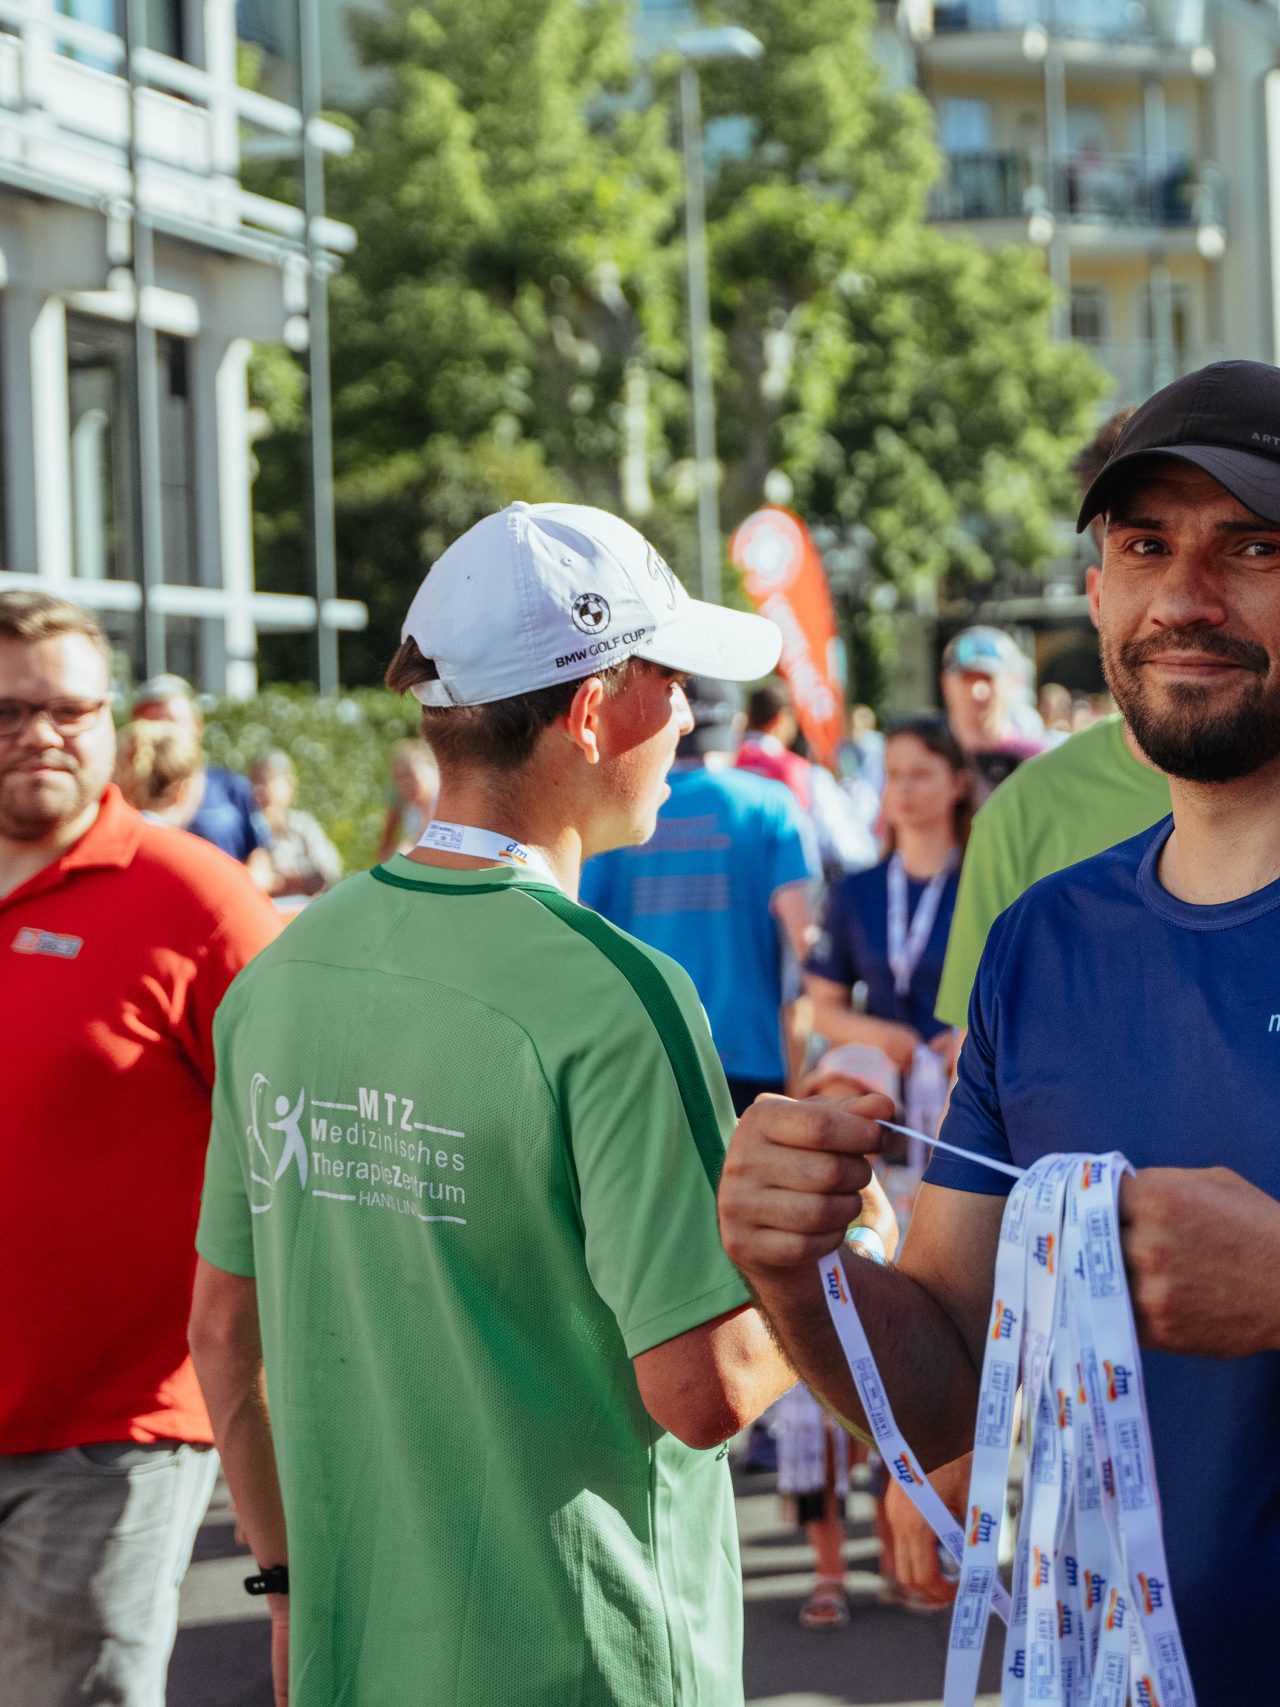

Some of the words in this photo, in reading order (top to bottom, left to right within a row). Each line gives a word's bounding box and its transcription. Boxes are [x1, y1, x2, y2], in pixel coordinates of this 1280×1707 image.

[555, 650, 588, 668] BMW
[589, 636, 621, 656] GOLF
[621, 628, 646, 645] CUP
[505, 842, 528, 860] dm
[358, 1087, 414, 1132] MTZ
[311, 1118, 466, 1172] Medizinisches
[1033, 1236, 1048, 1267] dm
[827, 1271, 840, 1300] dm
[1001, 1308, 1017, 1339] dm
[1114, 1364, 1132, 1395] dm
[893, 1458, 914, 1484] dm
[978, 1512, 997, 1543] dm
[1040, 1553, 1051, 1585] dm
[1065, 1556, 1078, 1587] dm
[1090, 1573, 1106, 1603] dm
[1147, 1577, 1164, 1608] dm
[1062, 1604, 1072, 1635] dm
[1113, 1596, 1127, 1629] dm
[1008, 1649, 1025, 1679] dm
